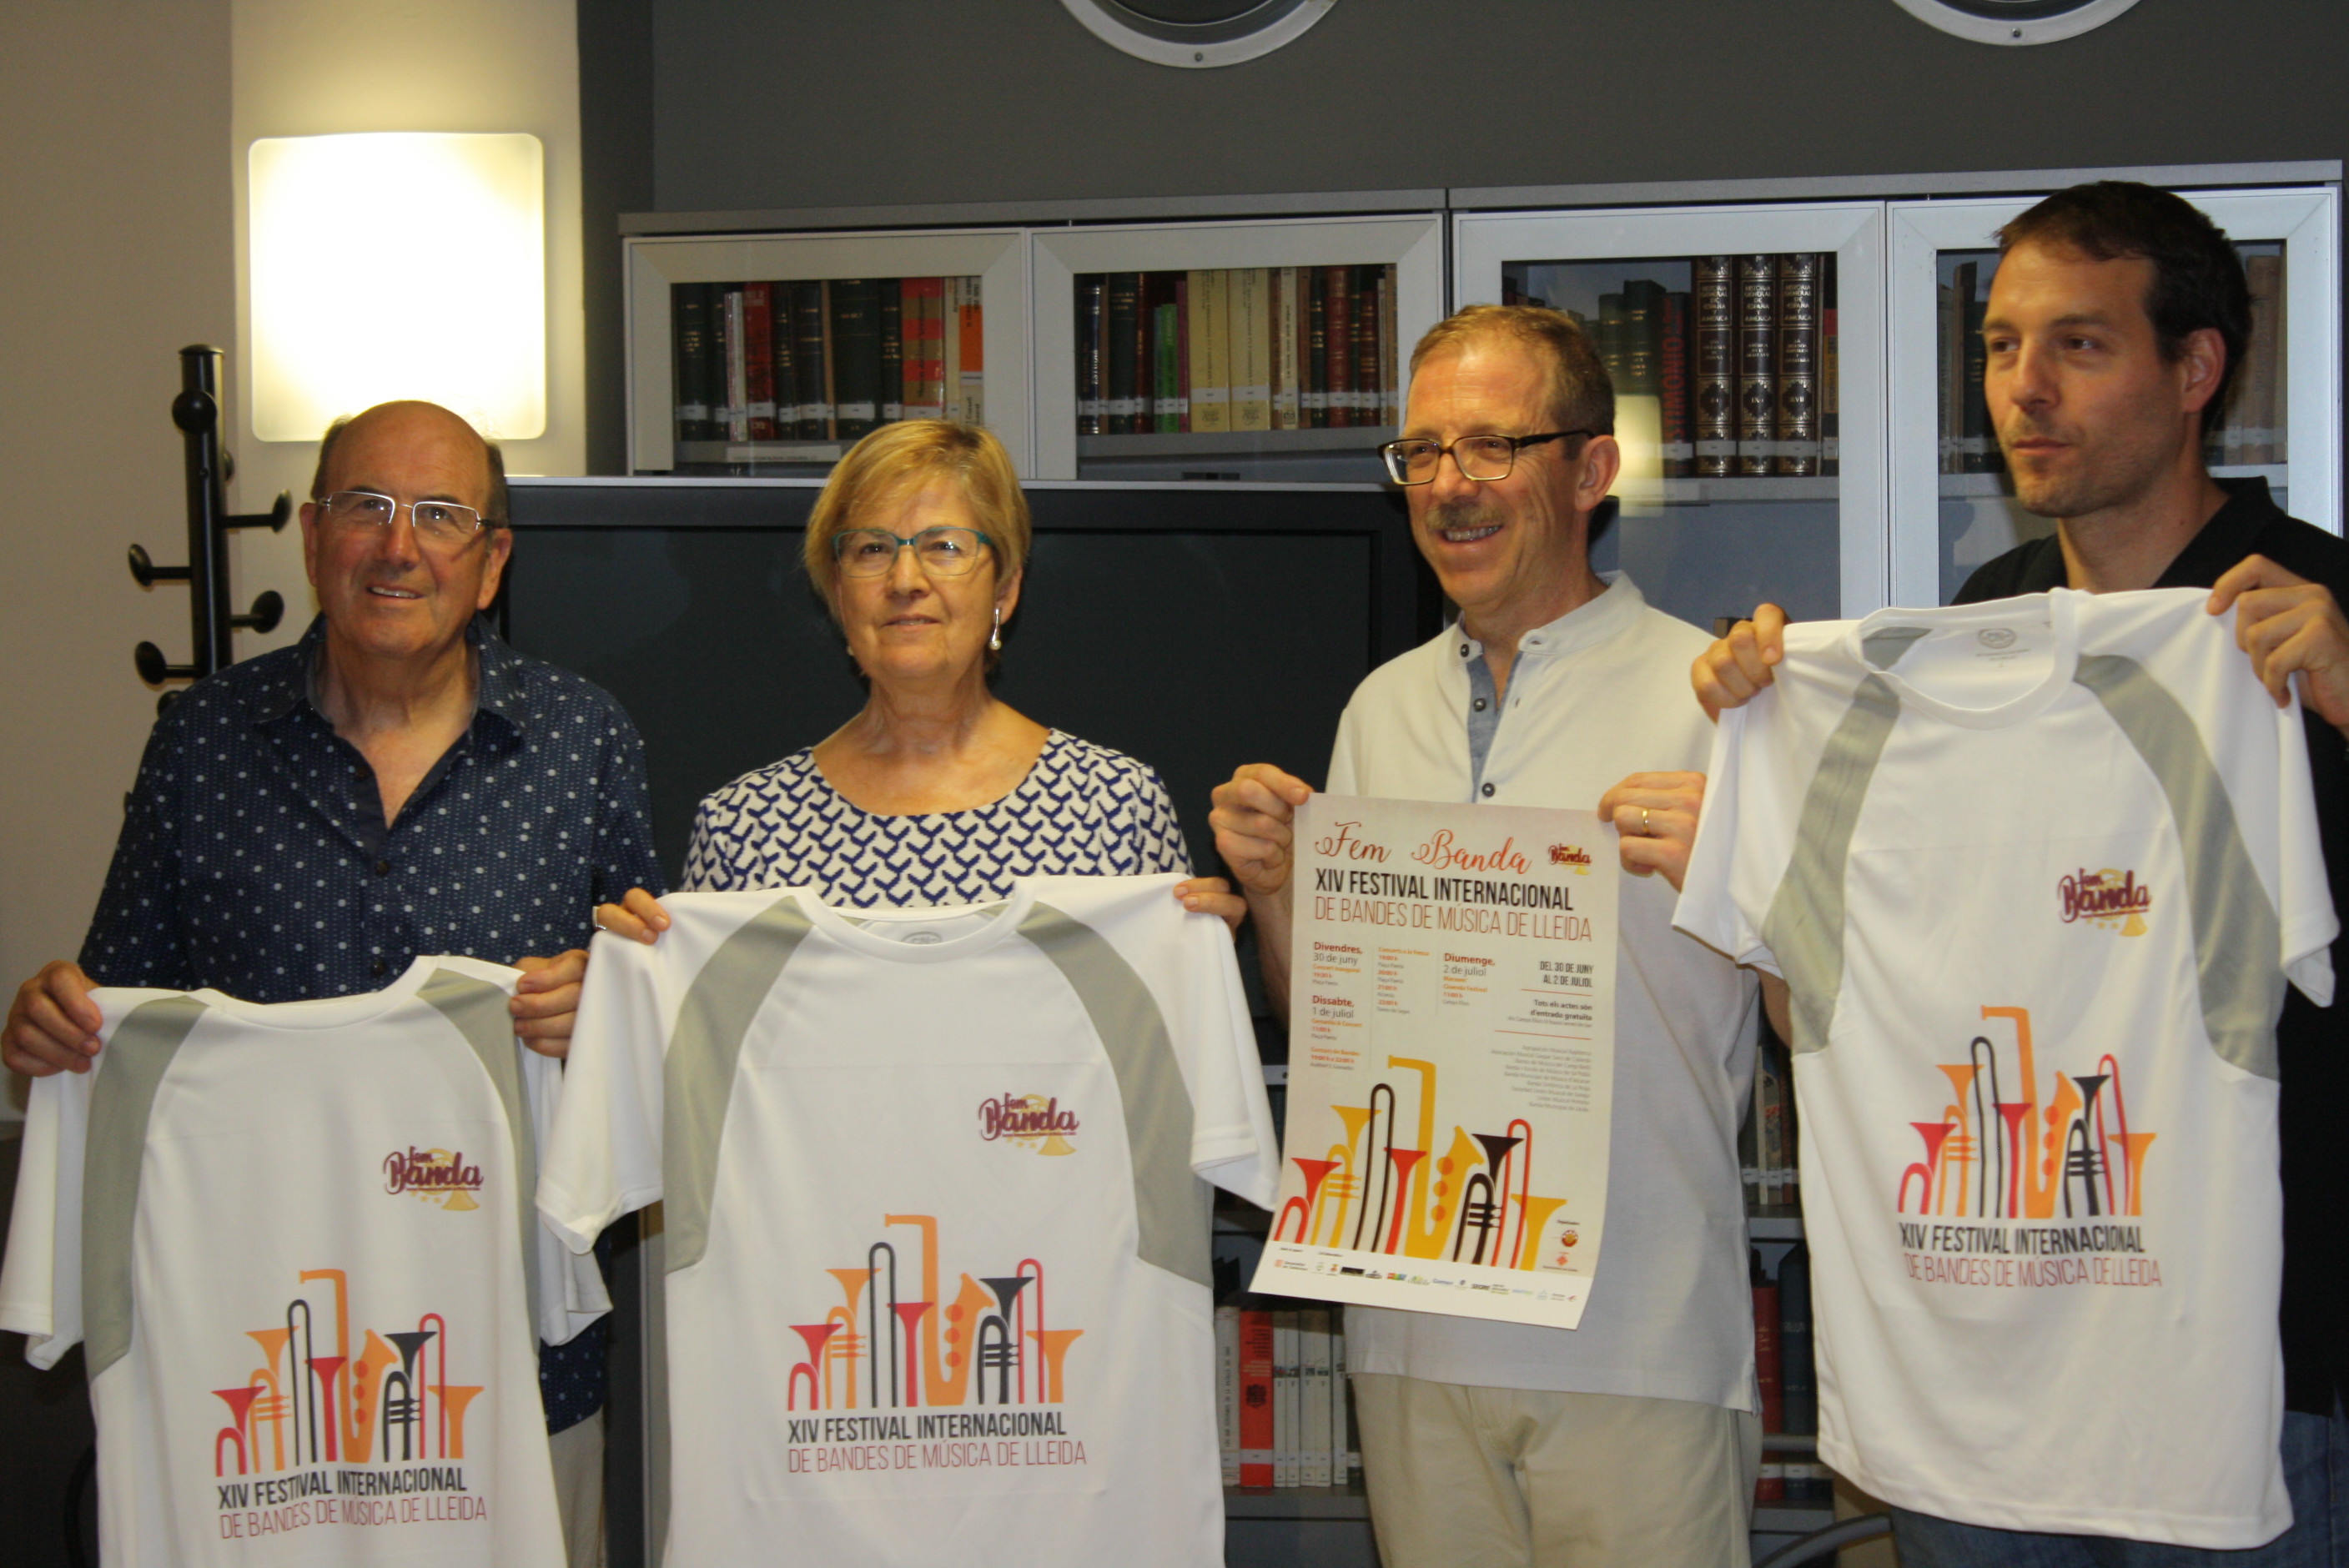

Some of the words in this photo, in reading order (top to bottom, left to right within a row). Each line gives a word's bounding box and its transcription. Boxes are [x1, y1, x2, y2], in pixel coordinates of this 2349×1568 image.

[1315, 822, 1391, 863] Fem
[1411, 829, 1532, 875] Banda
[1315, 867, 1345, 892] XIV
[1350, 870, 1429, 899] FESTIVAL
[1434, 877, 1574, 911] INTERNACIONAL
[2057, 870, 2152, 923] Banda
[1315, 896, 1336, 921] DE
[1340, 898, 1407, 927] BANDES
[1412, 904, 1433, 929] DE
[1438, 902, 1501, 934] MÚSICA
[1507, 912, 1528, 937] DE
[1533, 913, 1592, 942] LLEIDA
[1314, 942, 1363, 955] Divendres,
[1314, 952, 1325, 962] 30
[1326, 953, 1337, 962] de
[1339, 956, 1358, 966] juny
[1444, 952, 1495, 967] Diumenge,
[1443, 964, 1449, 973] 2
[1451, 965, 1462, 974] de
[1464, 967, 1486, 977] juliol
[1540, 961, 1553, 971] DEL
[1555, 962, 1564, 972] 30
[1566, 962, 1574, 972] DE
[1576, 963, 1593, 974] JUNY
[1543, 974, 1552, 984] AL
[1554, 975, 1558, 984] 2
[1560, 976, 1568, 985] DE
[1571, 977, 1592, 988] JULIOL
[1312, 995, 1355, 1008] Dissabte,
[1313, 1007, 1317, 1015] 1
[1320, 1008, 1330, 1016] de
[1332, 1009, 1354, 1018] juliol
[978, 1098, 1080, 1141] Banda
[383, 1152, 484, 1194] Banda
[1899, 1222, 1927, 1250] XIV
[1932, 1225, 2010, 1254] FESTIVAL
[2015, 1225, 2145, 1255] INTERNACIONAL
[1904, 1253, 1923, 1280] DE
[1924, 1255, 1991, 1286] BANDES
[1995, 1259, 2014, 1287] DE
[2018, 1255, 2090, 1287] MÚSICA
[2093, 1257, 2111, 1284] DE
[2112, 1259, 2162, 1287] LLEIDA
[788, 1419, 819, 1444] XIV
[825, 1415, 912, 1442] FESTIVAL
[918, 1412, 1067, 1440] INTERNACIONAL
[789, 1448, 812, 1473] DE
[817, 1445, 888, 1472] BANDES
[894, 1445, 917, 1470] DE
[923, 1439, 992, 1468] MÚSICA
[997, 1441, 1019, 1466] DE
[1026, 1440, 1087, 1465] LLEIDA
[218, 1483, 249, 1510] XIV
[254, 1470, 333, 1506] FESTIVAL
[337, 1467, 467, 1496] INTERNACIONAL
[220, 1514, 244, 1539] DE
[248, 1501, 310, 1537] BANDES
[316, 1499, 338, 1524] DE
[342, 1495, 397, 1525] MÚSICA
[401, 1497, 420, 1523] DE
[426, 1496, 487, 1520] LLEIDA
